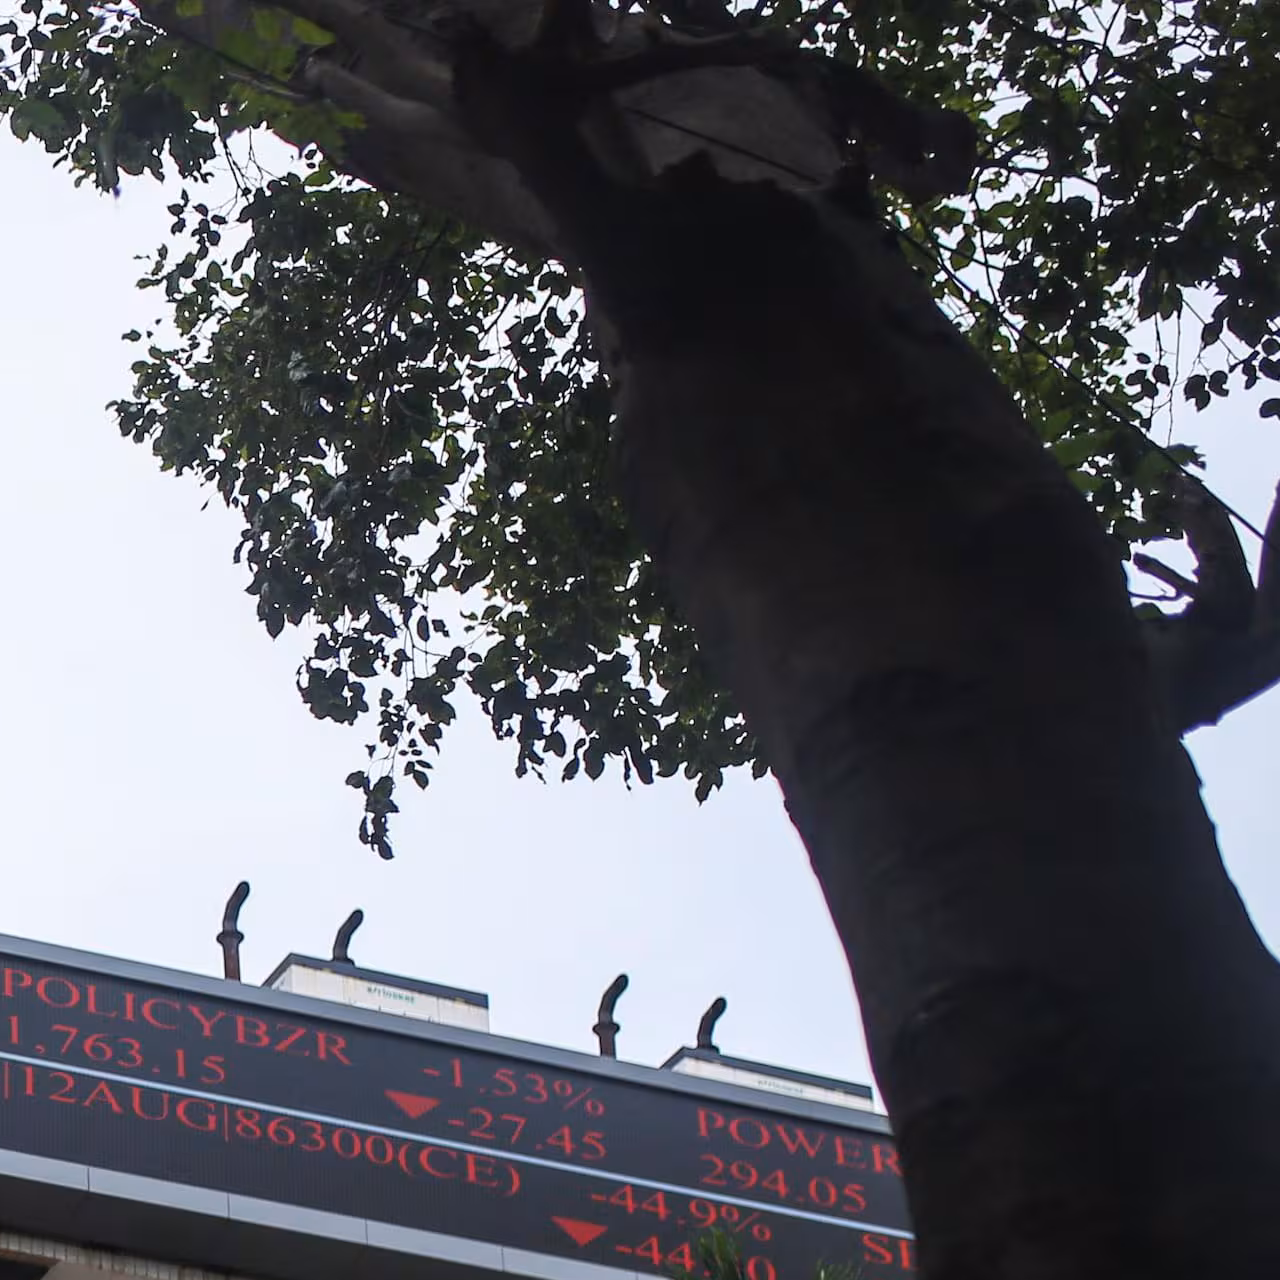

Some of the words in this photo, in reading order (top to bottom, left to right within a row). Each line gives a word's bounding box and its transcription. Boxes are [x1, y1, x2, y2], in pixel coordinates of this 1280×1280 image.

[4, 968, 348, 1064] POLICYBZR
[10, 1016, 224, 1080] 1,763.15
[426, 1060, 604, 1112] -1.53%
[452, 1108, 604, 1156] -27.45
[704, 1154, 866, 1210] 294.05
[592, 1186, 772, 1240] -44.9%
